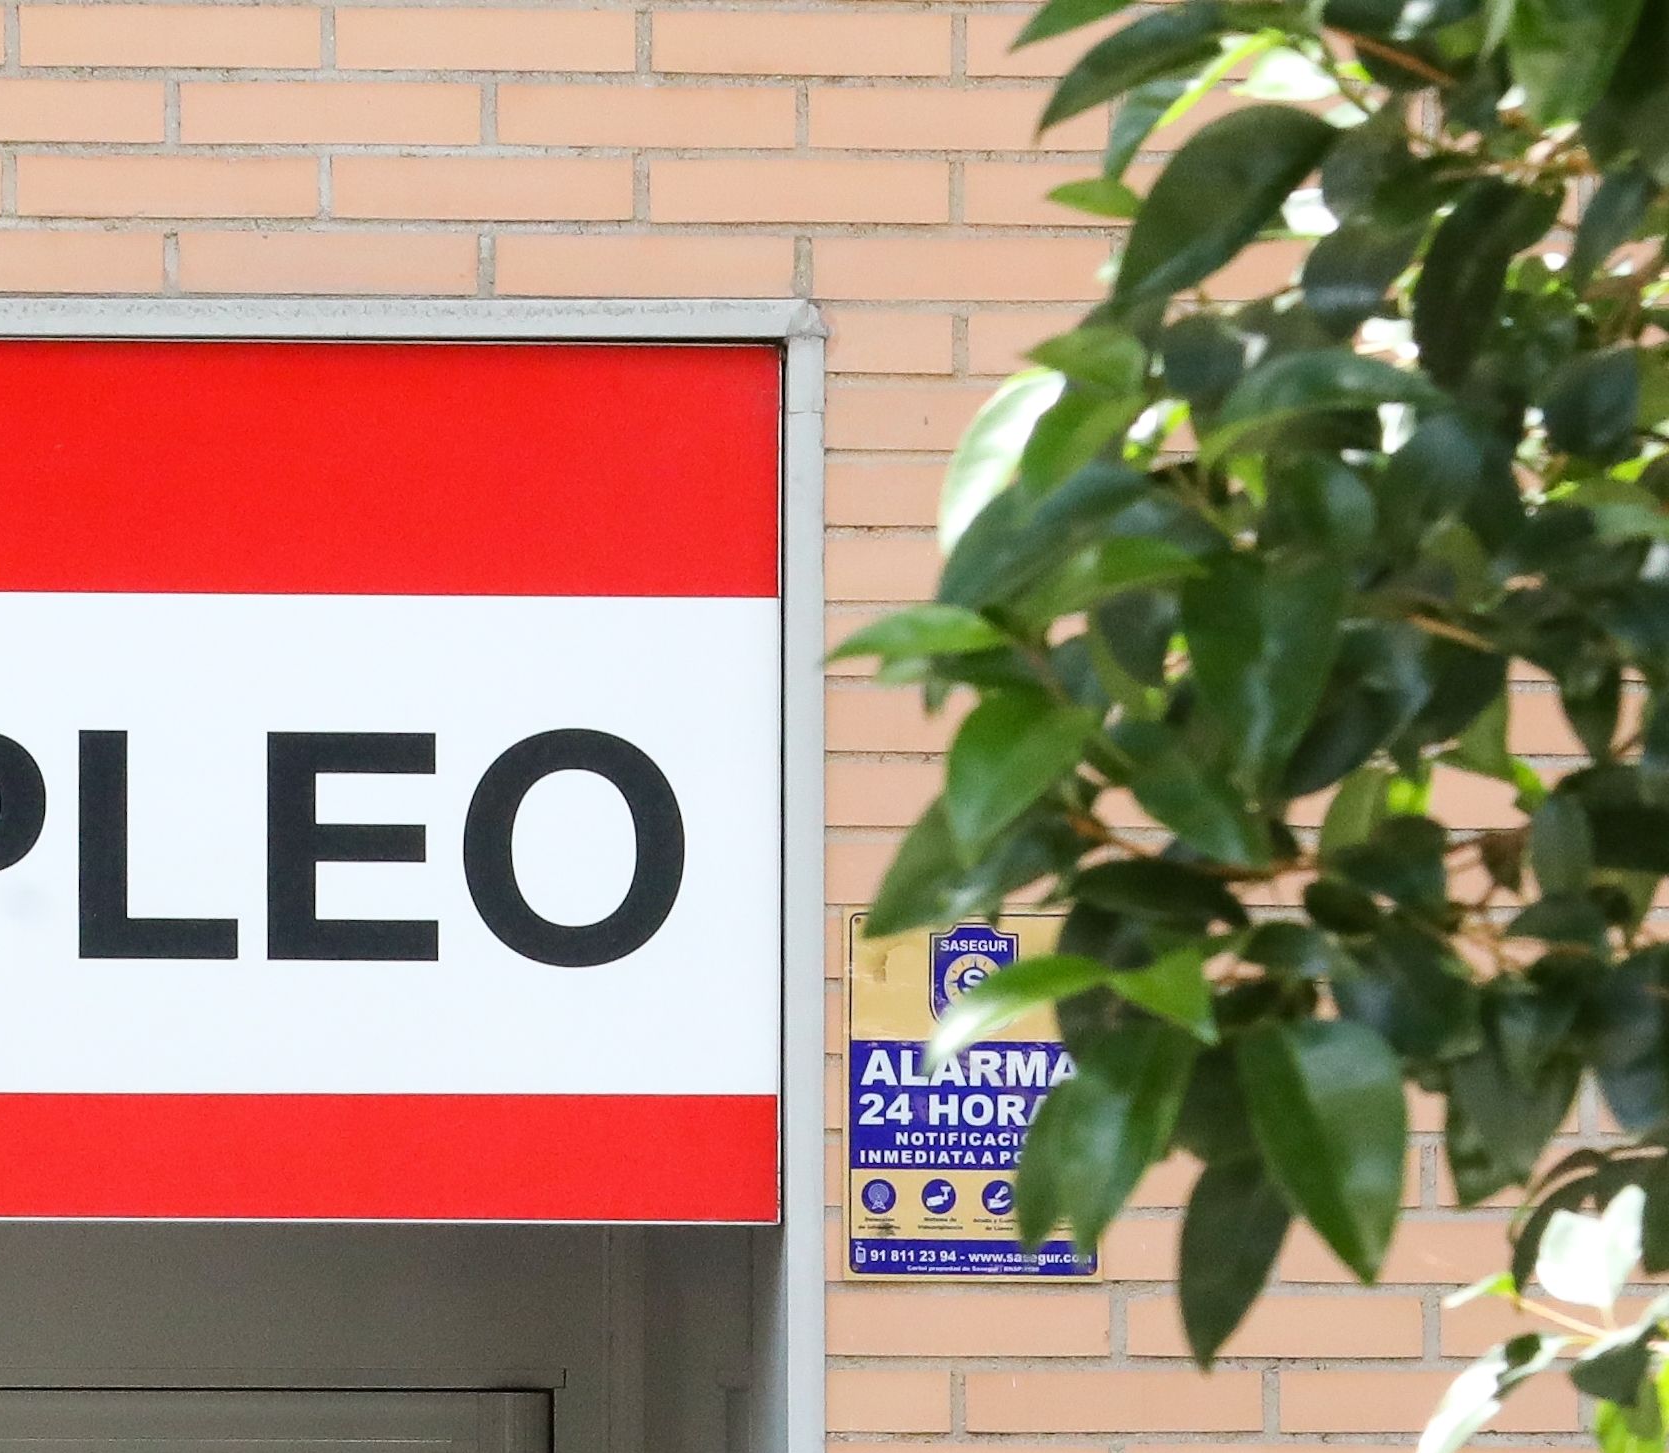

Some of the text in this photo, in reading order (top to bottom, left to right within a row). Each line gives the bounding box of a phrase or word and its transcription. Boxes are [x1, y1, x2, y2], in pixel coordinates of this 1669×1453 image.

[940, 939, 1008, 952] SASEGUR
[858, 1093, 1049, 1126] 24 HOR
[860, 1150, 976, 1165] INMEDIATA
[981, 1150, 995, 1165] A
[870, 1249, 886, 1263] 91
[891, 1249, 915, 1263] 811
[919, 1249, 936, 1263] 23
[940, 1249, 957, 1263] 94
